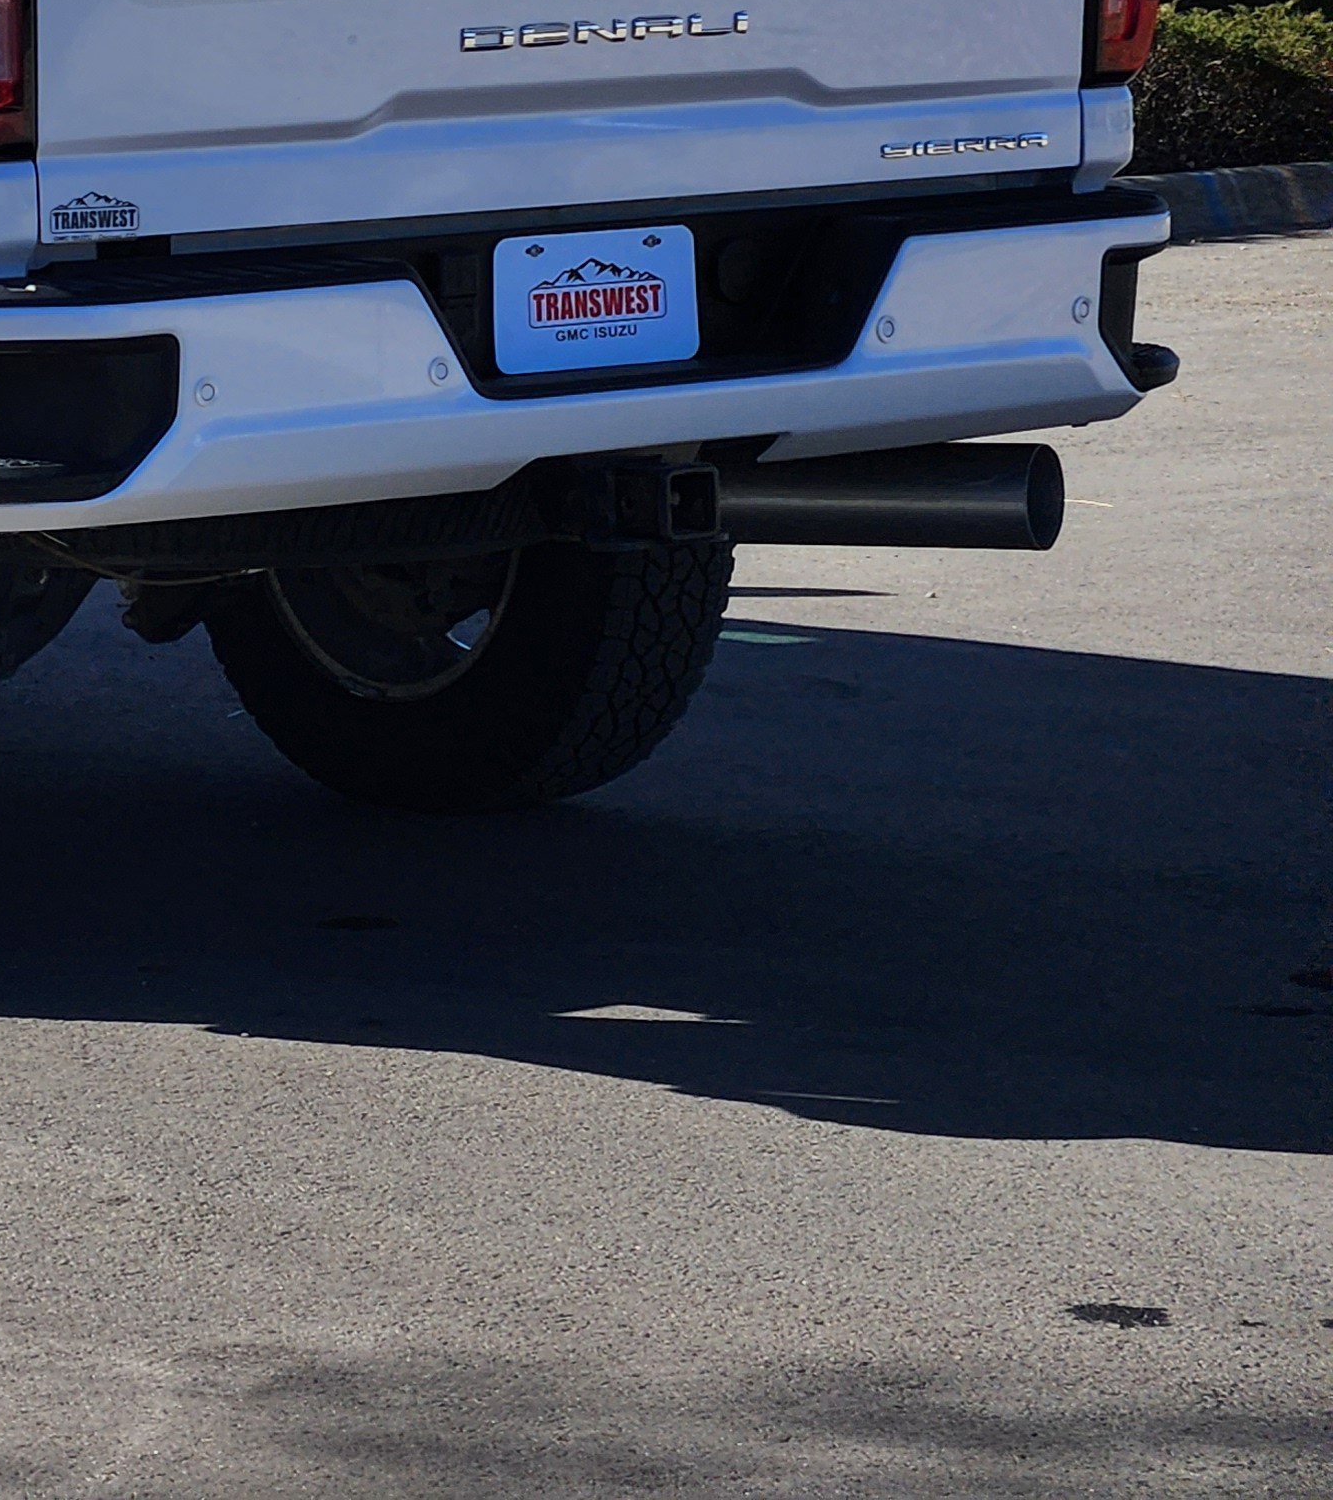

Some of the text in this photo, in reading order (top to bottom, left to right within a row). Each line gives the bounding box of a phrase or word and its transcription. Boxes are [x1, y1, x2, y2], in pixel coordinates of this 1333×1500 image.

[459, 10, 750, 53] DENALI
[879, 131, 1049, 159] SIERRA
[52, 208, 137, 231] TRANSWEST
[532, 284, 662, 323] TRANSWEST
[555, 324, 638, 342] GMC ISUZU
